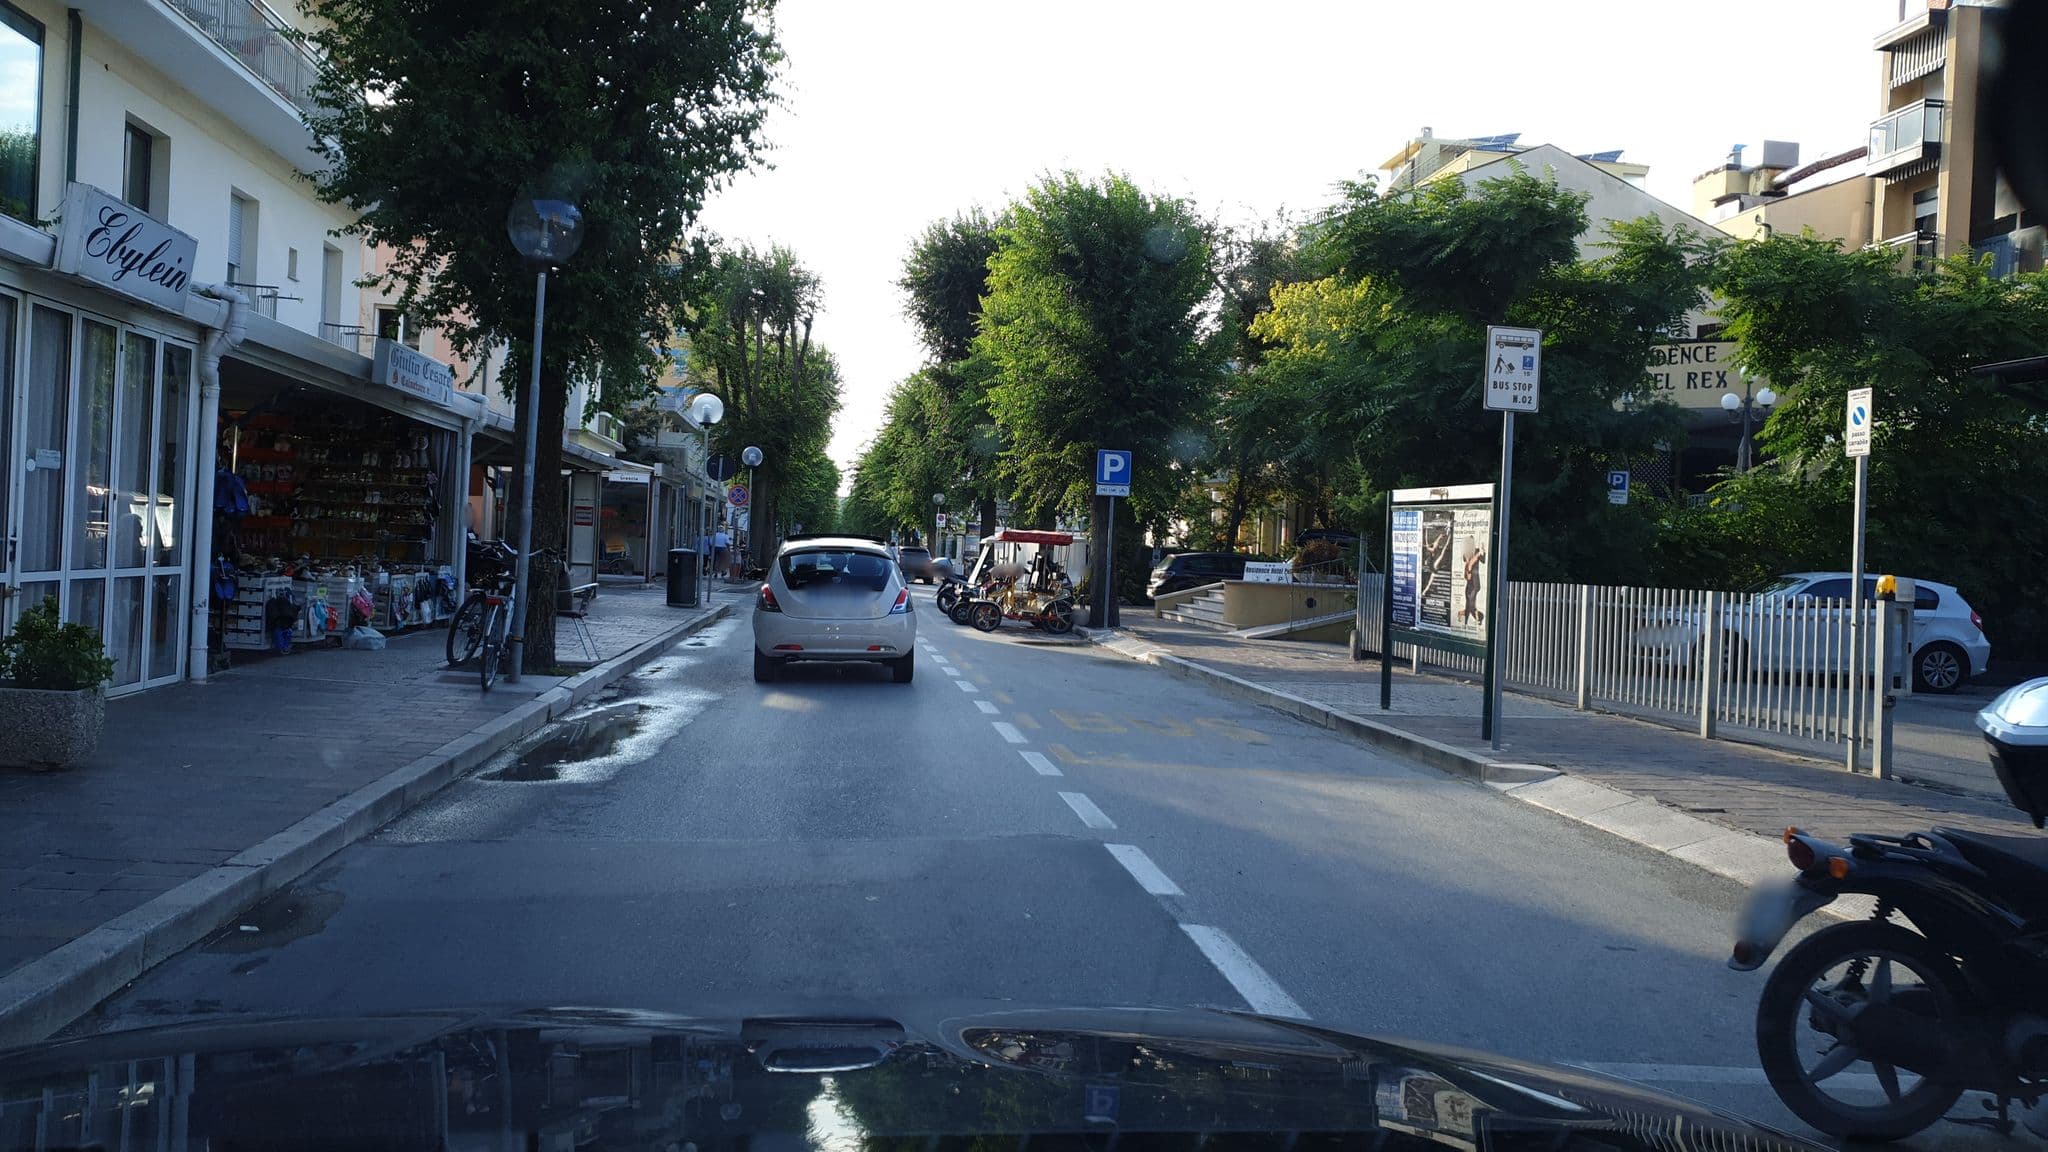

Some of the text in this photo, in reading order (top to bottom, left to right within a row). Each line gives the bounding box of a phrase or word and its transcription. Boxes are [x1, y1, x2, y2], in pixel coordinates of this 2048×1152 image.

[86, 206, 187, 293] Ebylein
[390, 347, 452, 388] Giulio Cesare
[1686, 370, 1728, 390] REX
[1492, 380, 1533, 392] BUS STOP
[1103, 453, 1125, 481] P
[1612, 474, 1624, 486] P
[1050, 708, 1273, 743] BUS
